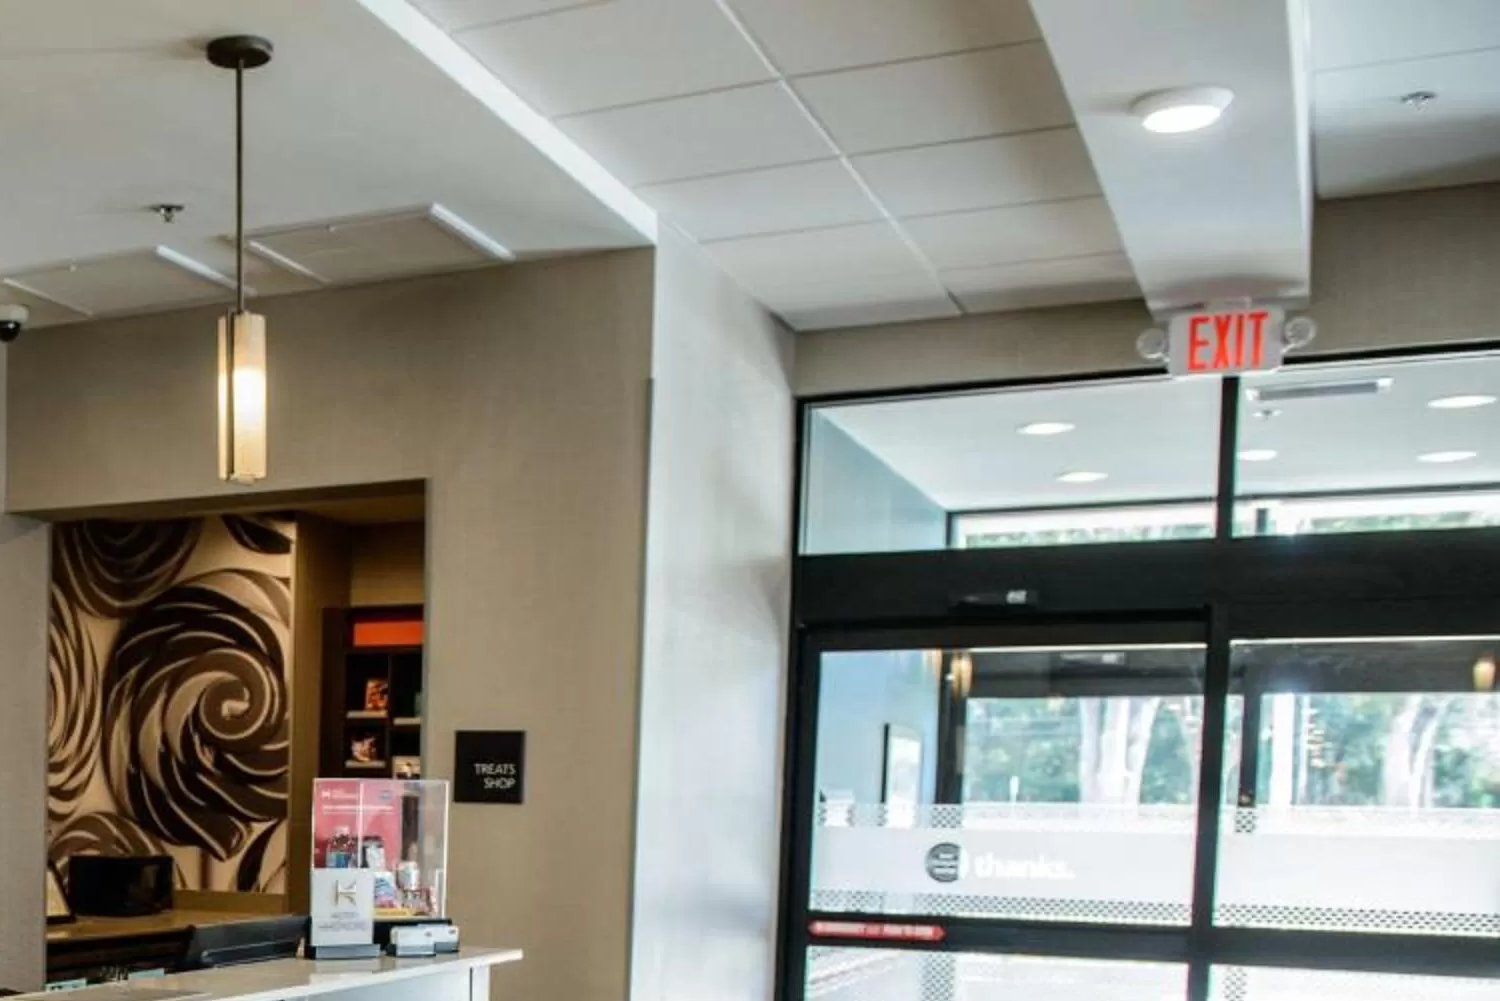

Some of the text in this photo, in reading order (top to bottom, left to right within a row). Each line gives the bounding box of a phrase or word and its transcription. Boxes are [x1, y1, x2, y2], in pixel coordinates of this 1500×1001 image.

[1188, 311, 1268, 371] EXIT
[473, 763, 516, 776] TREATS
[483, 777, 516, 789] SHOP
[975, 852, 1076, 879] thanks.
